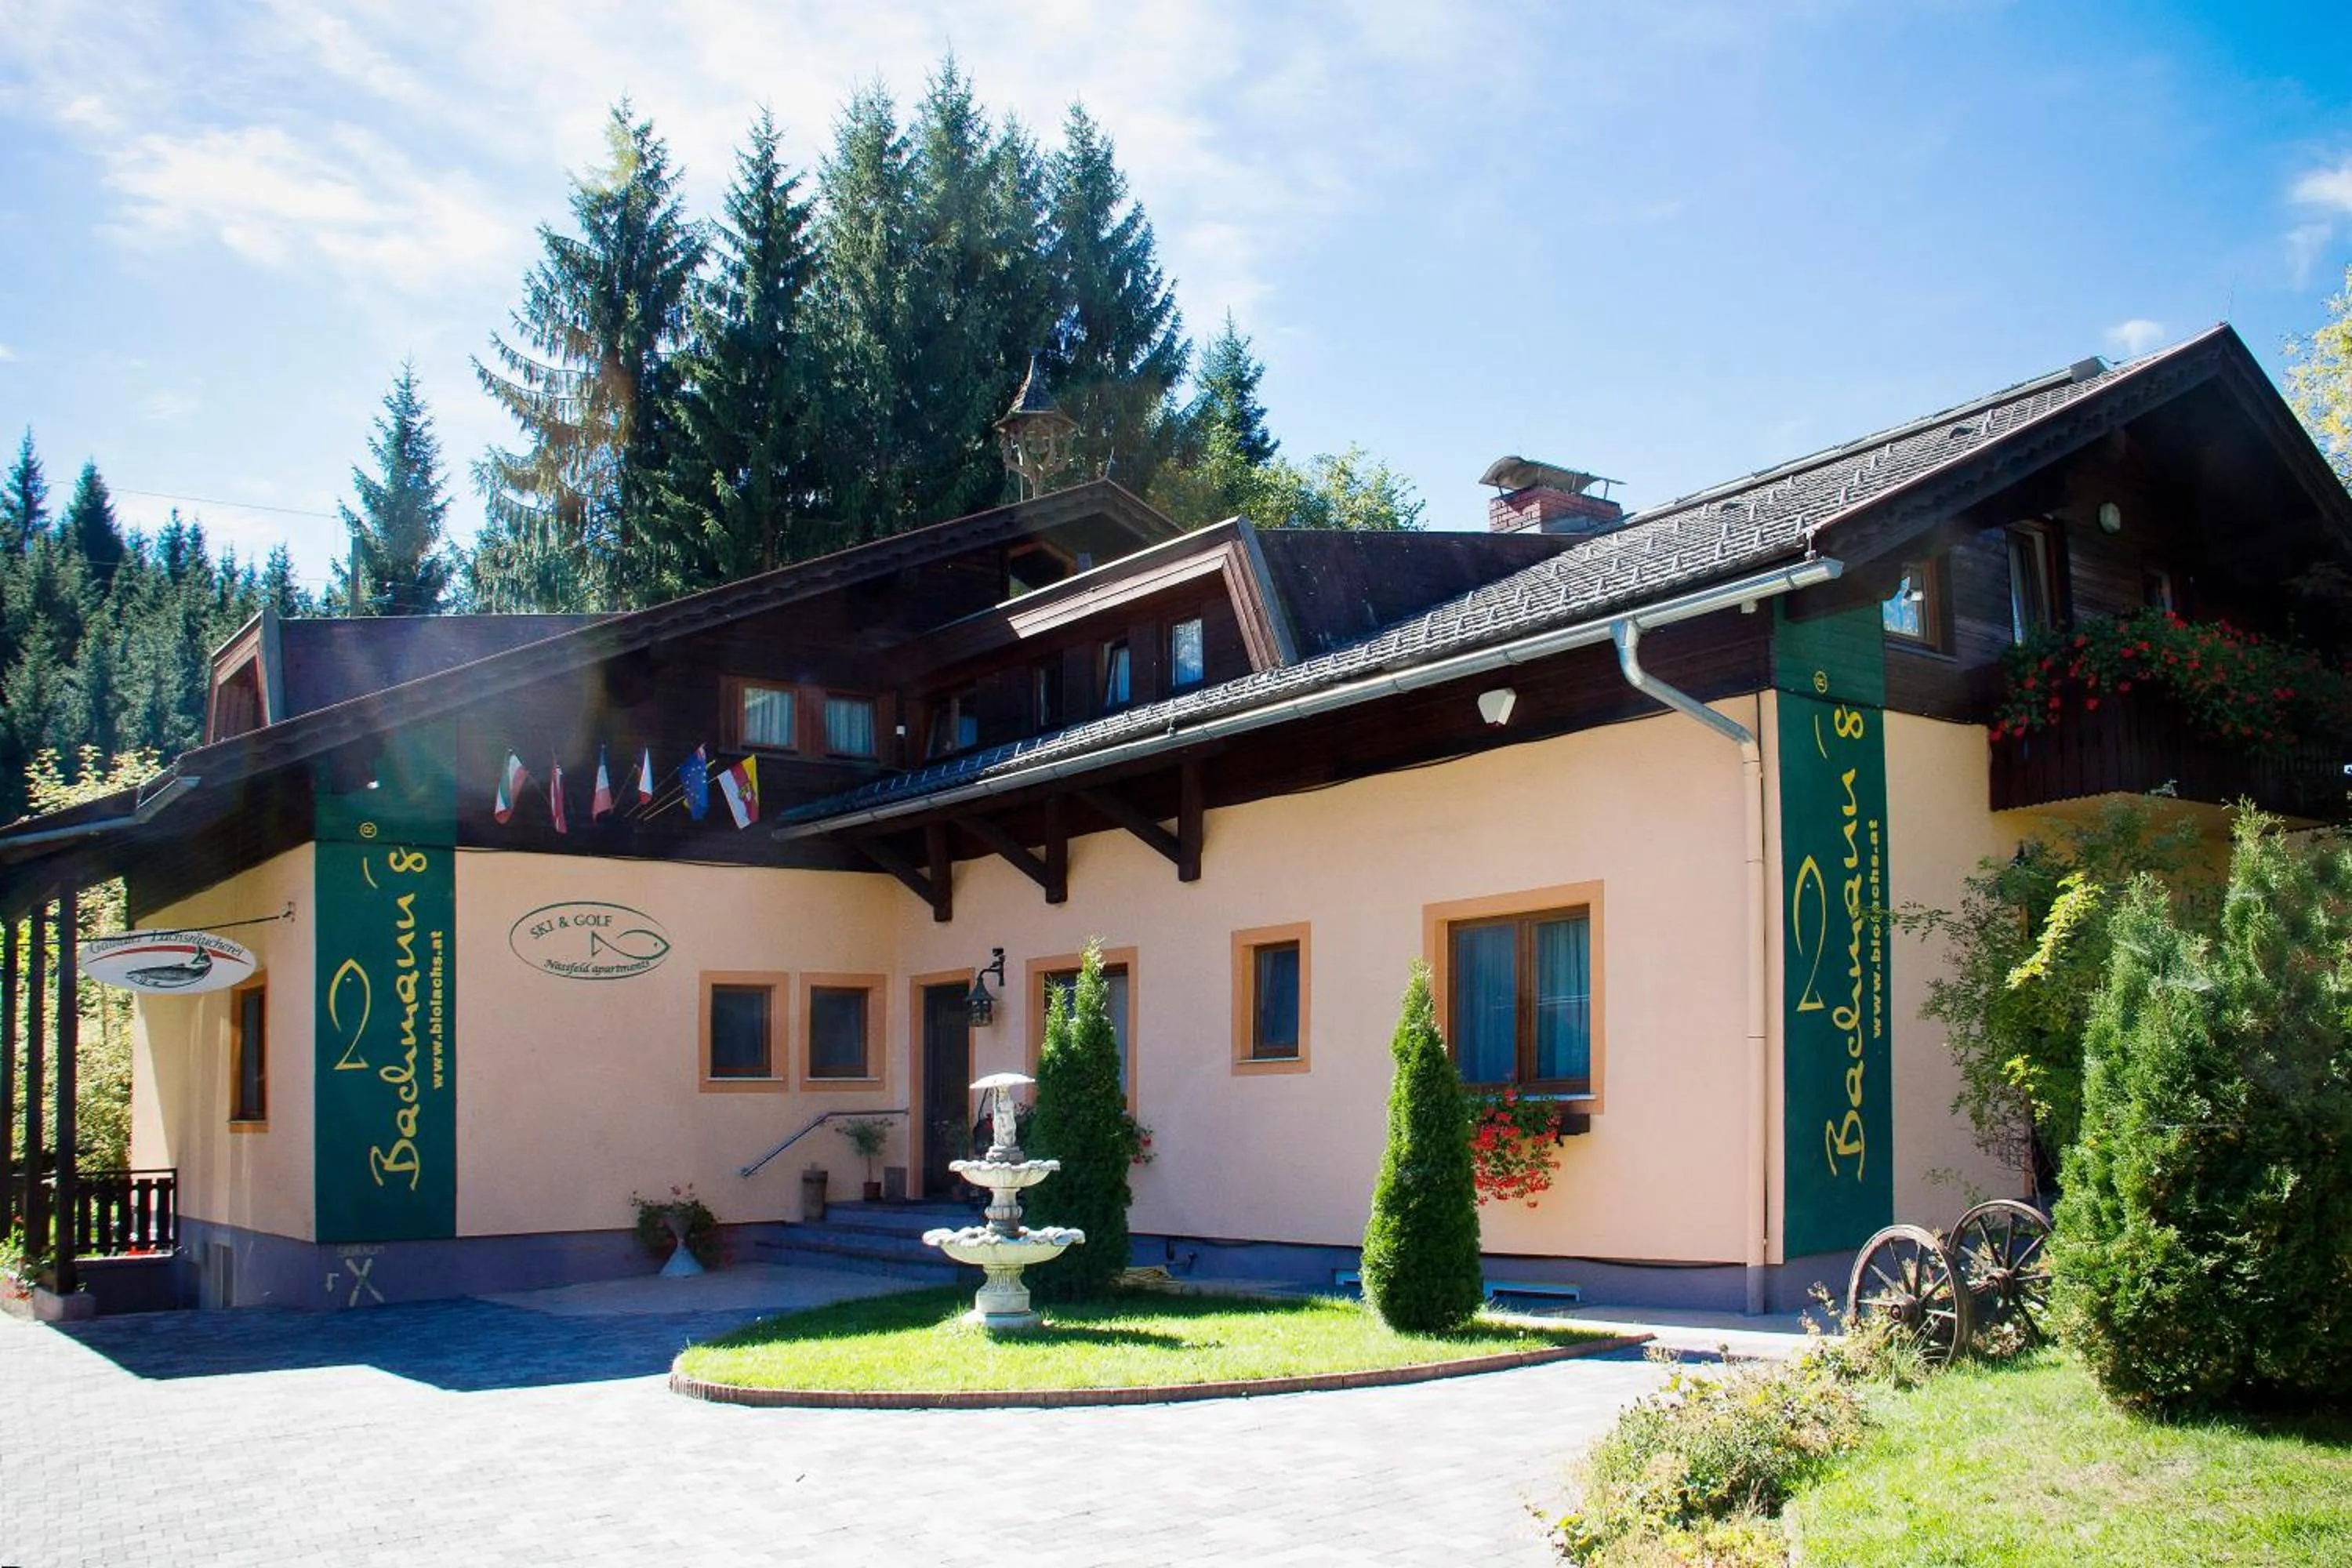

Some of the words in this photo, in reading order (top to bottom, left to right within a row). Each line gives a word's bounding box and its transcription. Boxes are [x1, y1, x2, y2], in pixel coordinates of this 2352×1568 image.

[530, 920, 554, 940] SKI
[559, 916, 570, 929] &
[574, 913, 612, 927] GOLF
[591, 960, 650, 975] apartments
[430, 931, 444, 1090] www.biolachs.at
